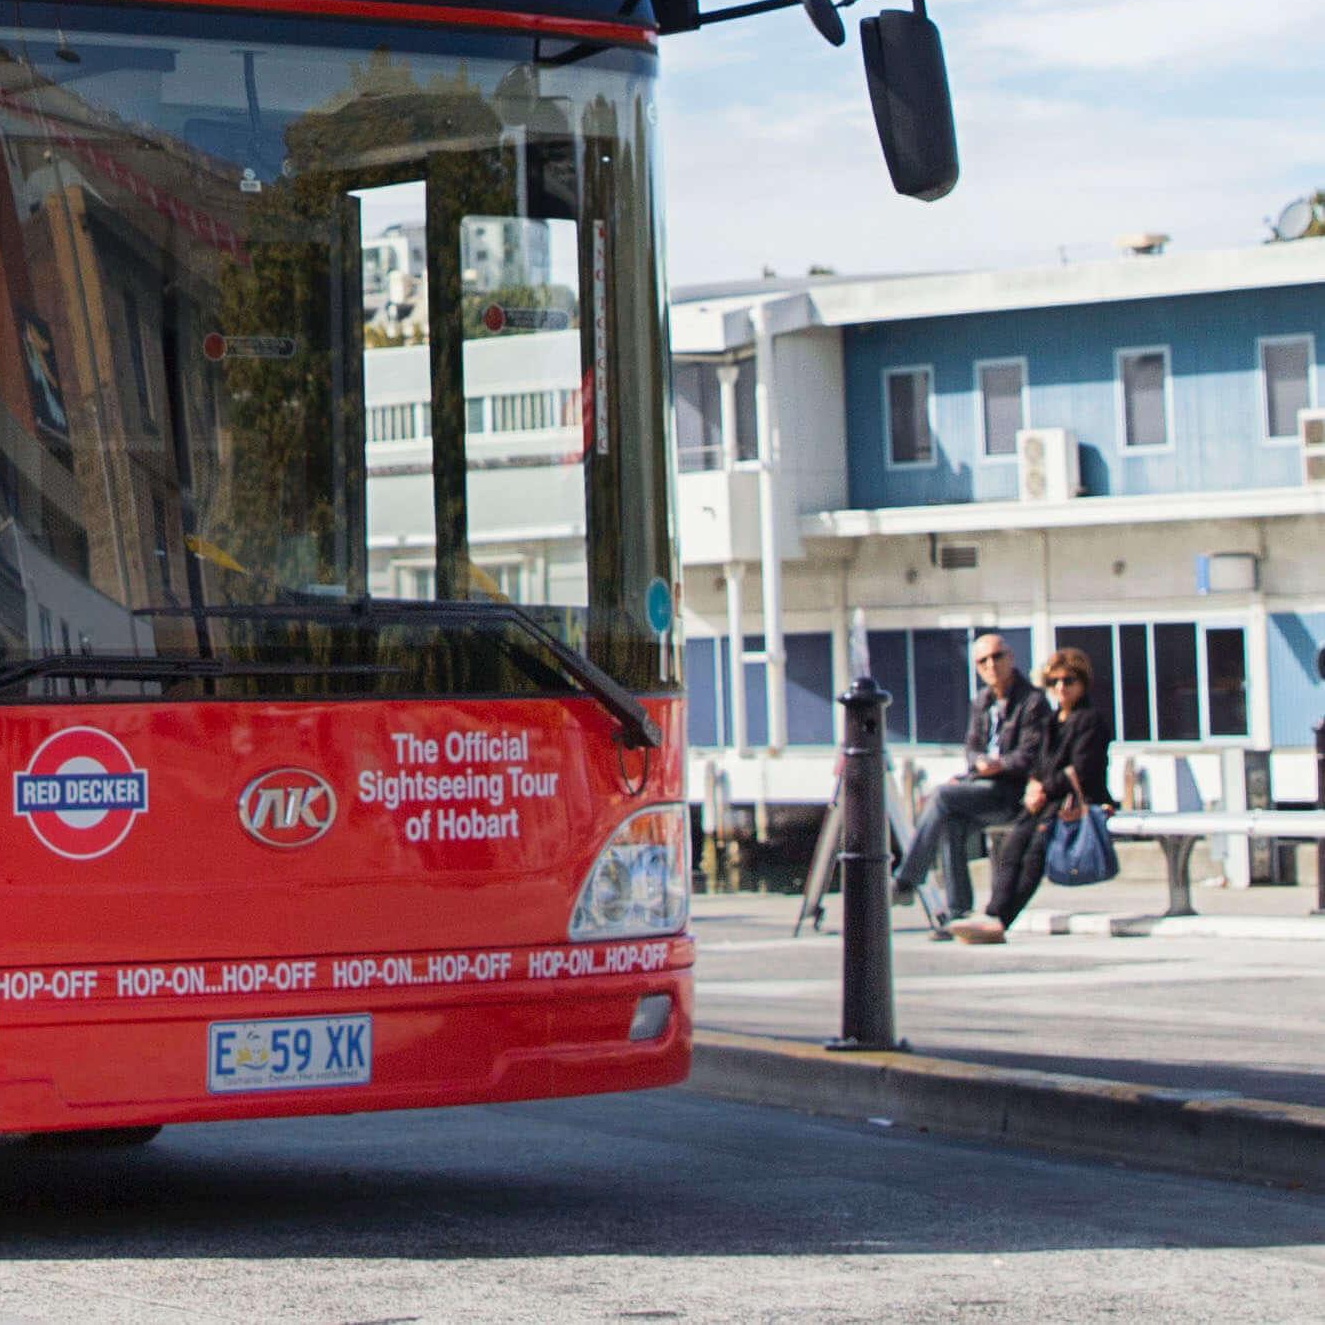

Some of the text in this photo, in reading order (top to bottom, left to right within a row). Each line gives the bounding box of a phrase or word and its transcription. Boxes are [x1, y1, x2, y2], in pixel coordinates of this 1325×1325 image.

[391, 729, 528, 764] The Official
[23, 779, 139, 805] RED DECKER
[358, 766, 559, 810] Sightseeing Tour
[405, 808, 519, 842] of Hobart
[215, 1024, 366, 1076] E 59 XK
